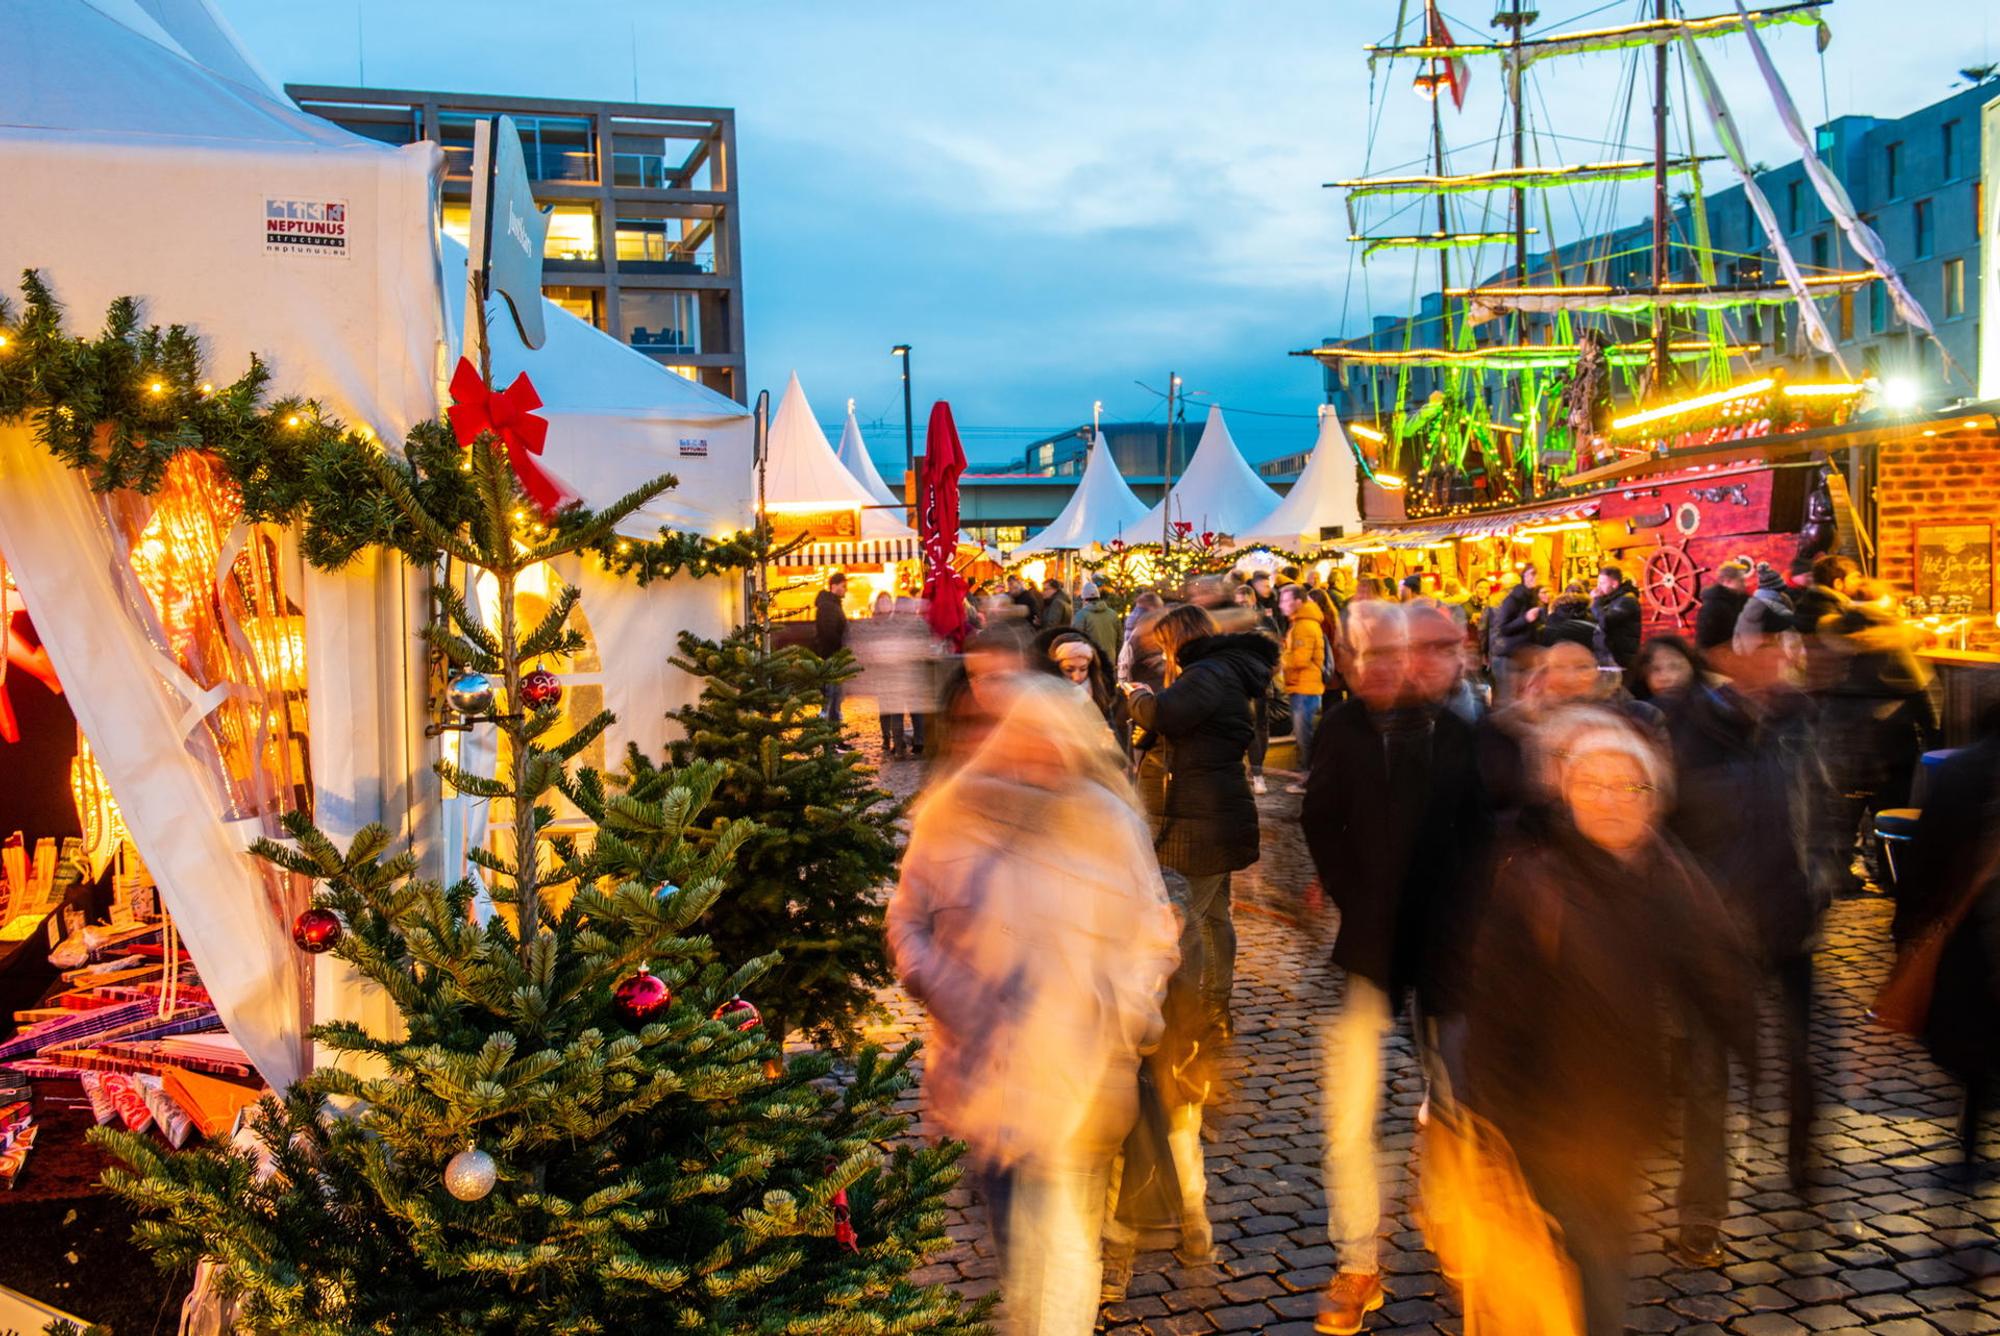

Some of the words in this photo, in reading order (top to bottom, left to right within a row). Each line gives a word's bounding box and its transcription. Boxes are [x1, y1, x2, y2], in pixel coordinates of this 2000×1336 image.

[267, 219, 345, 235] NEPTUNUS
[269, 234, 344, 246] structures
[266, 245, 346, 256] neptunus.eu
